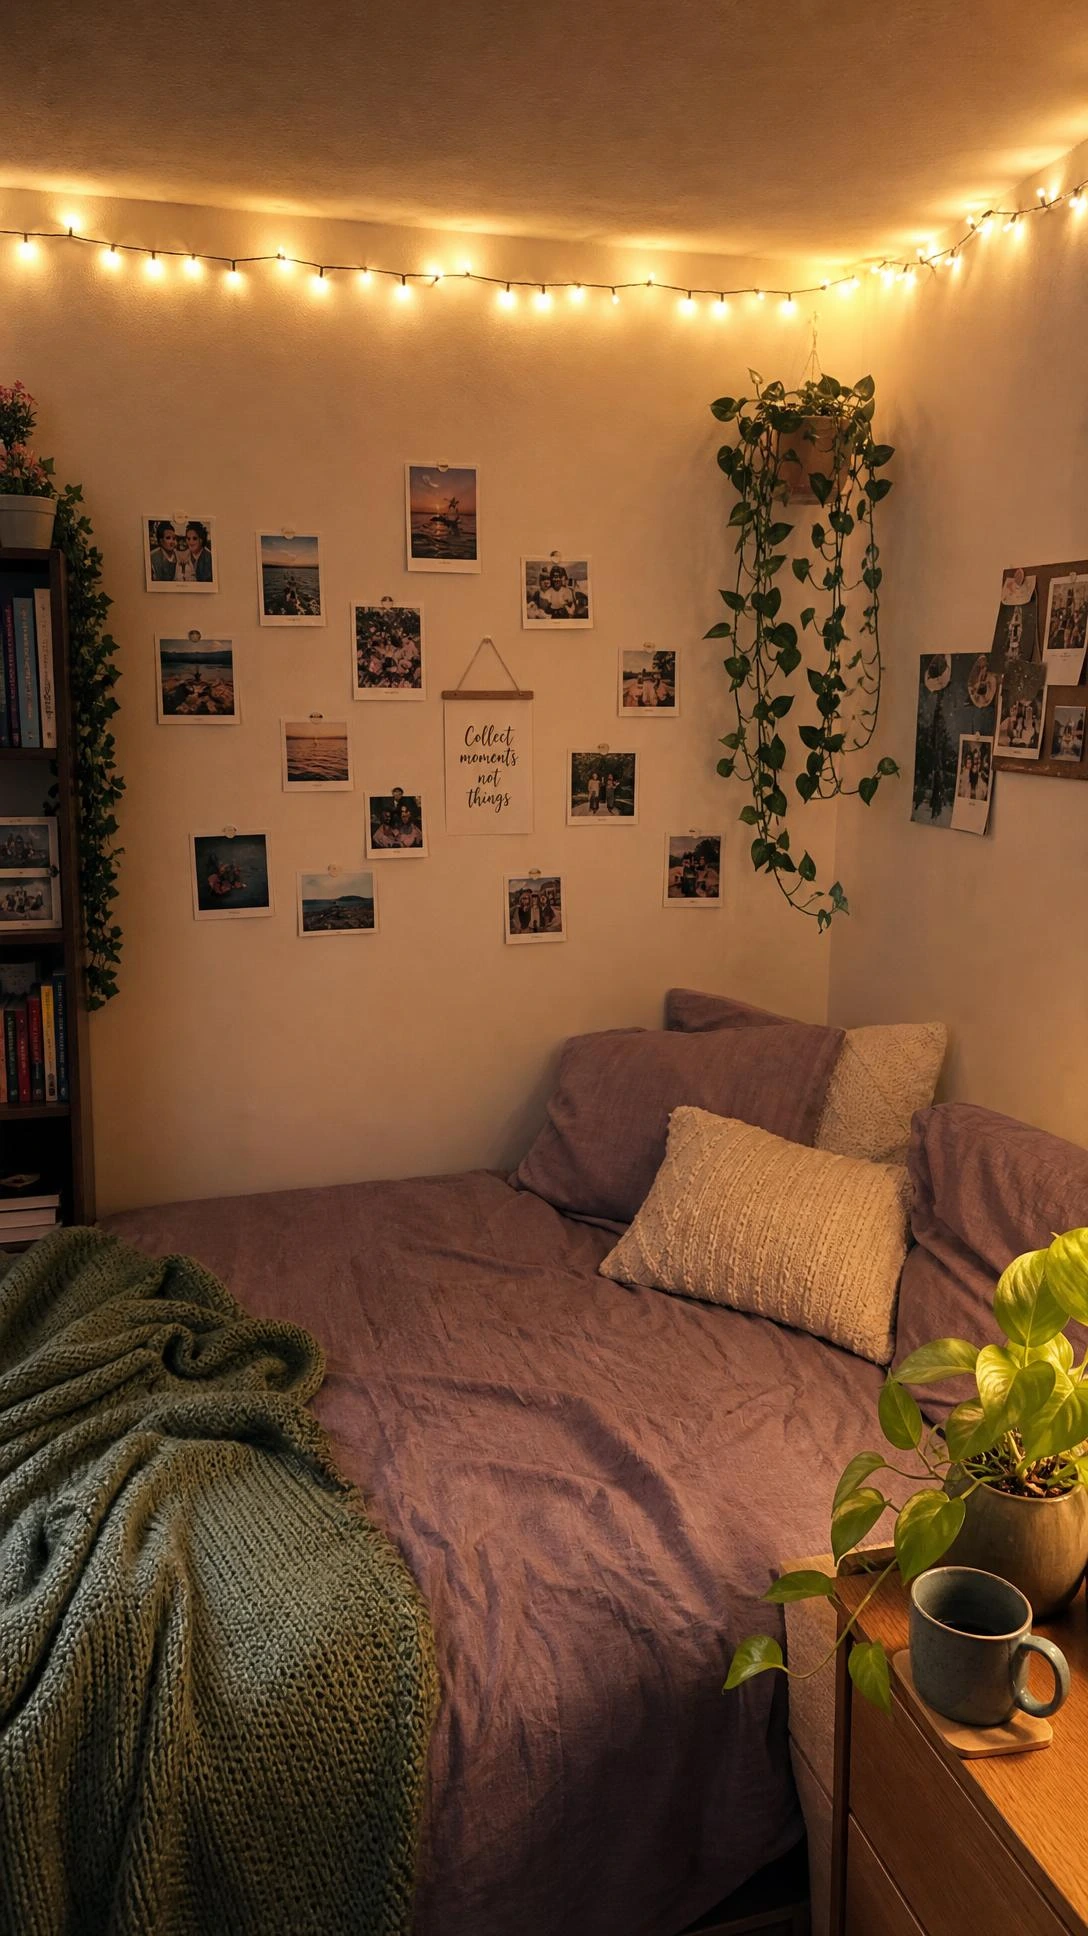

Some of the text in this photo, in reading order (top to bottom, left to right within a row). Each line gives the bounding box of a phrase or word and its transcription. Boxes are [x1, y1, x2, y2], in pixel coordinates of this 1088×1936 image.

[464, 724, 515, 747] Collect
[460, 748, 518, 767] moments
[478, 768, 502, 787] not
[466, 787, 512, 813] things
